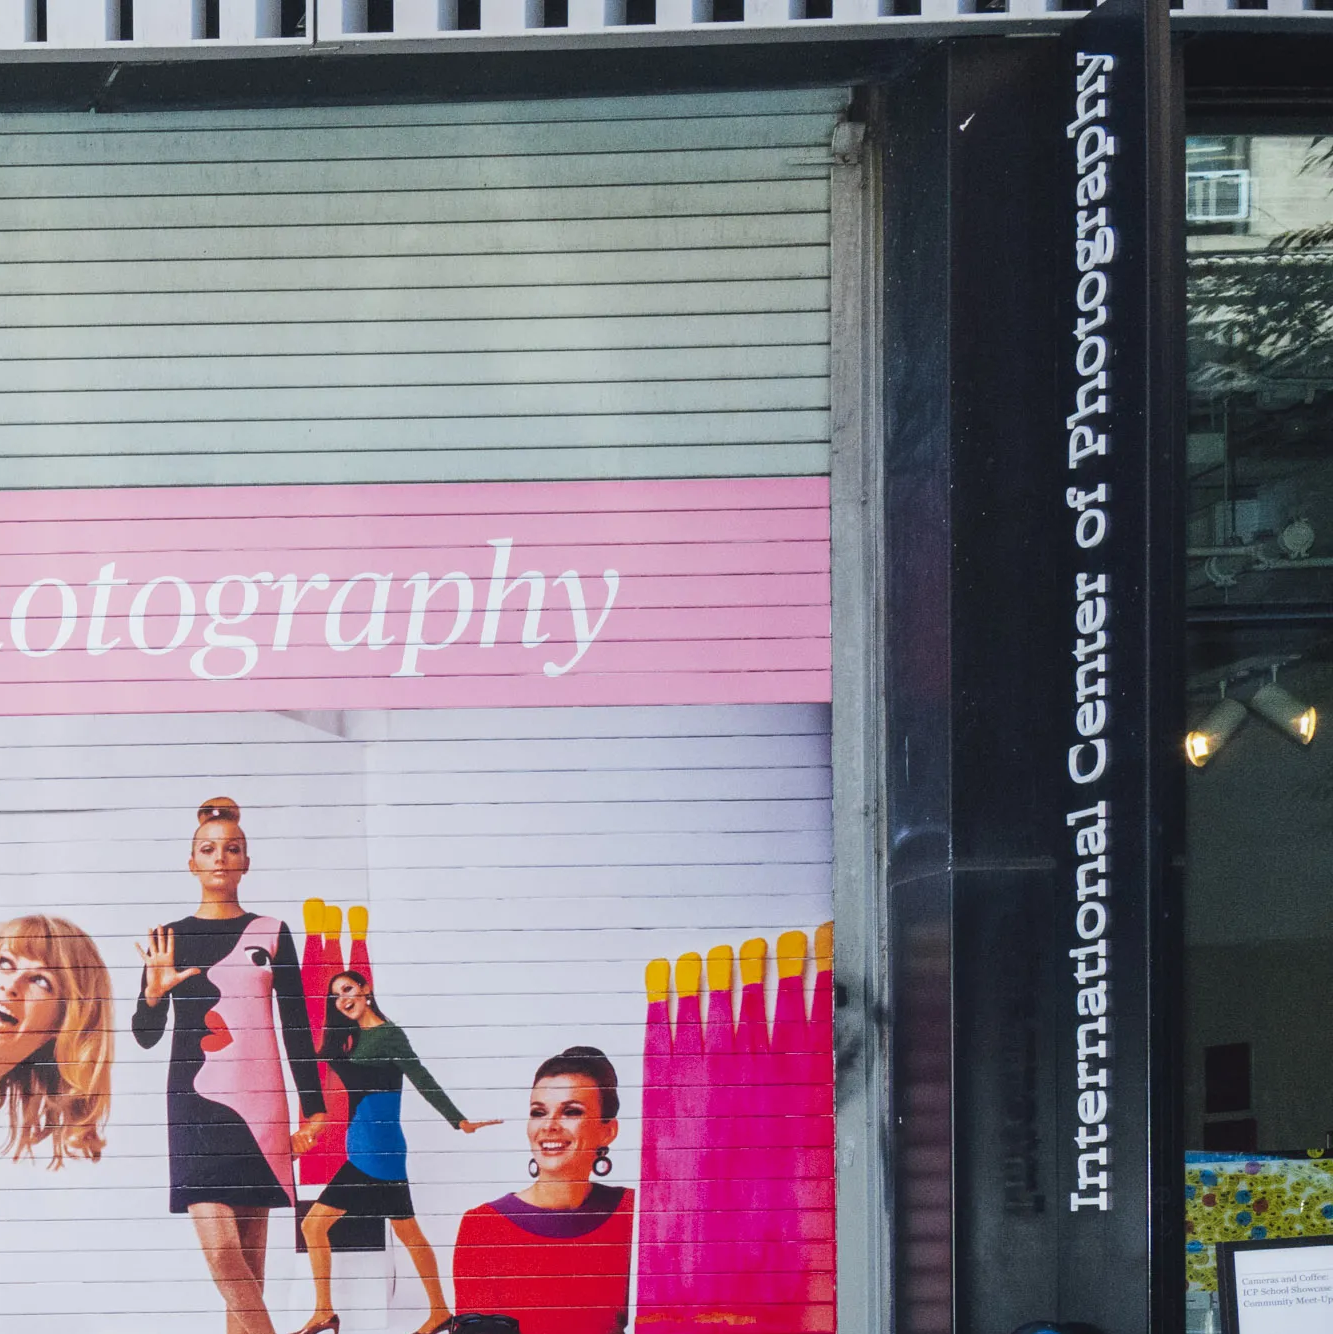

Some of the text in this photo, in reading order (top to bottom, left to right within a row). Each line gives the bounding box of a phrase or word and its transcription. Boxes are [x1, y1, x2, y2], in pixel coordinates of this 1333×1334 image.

[1066, 51, 1115, 1212] International Center of Photography
[1242, 1273, 1329, 1286] Cameras and Coffee:
[1243, 1284, 1332, 1297] ICP School Showcase
[1243, 1298, 1293, 1308] Community
